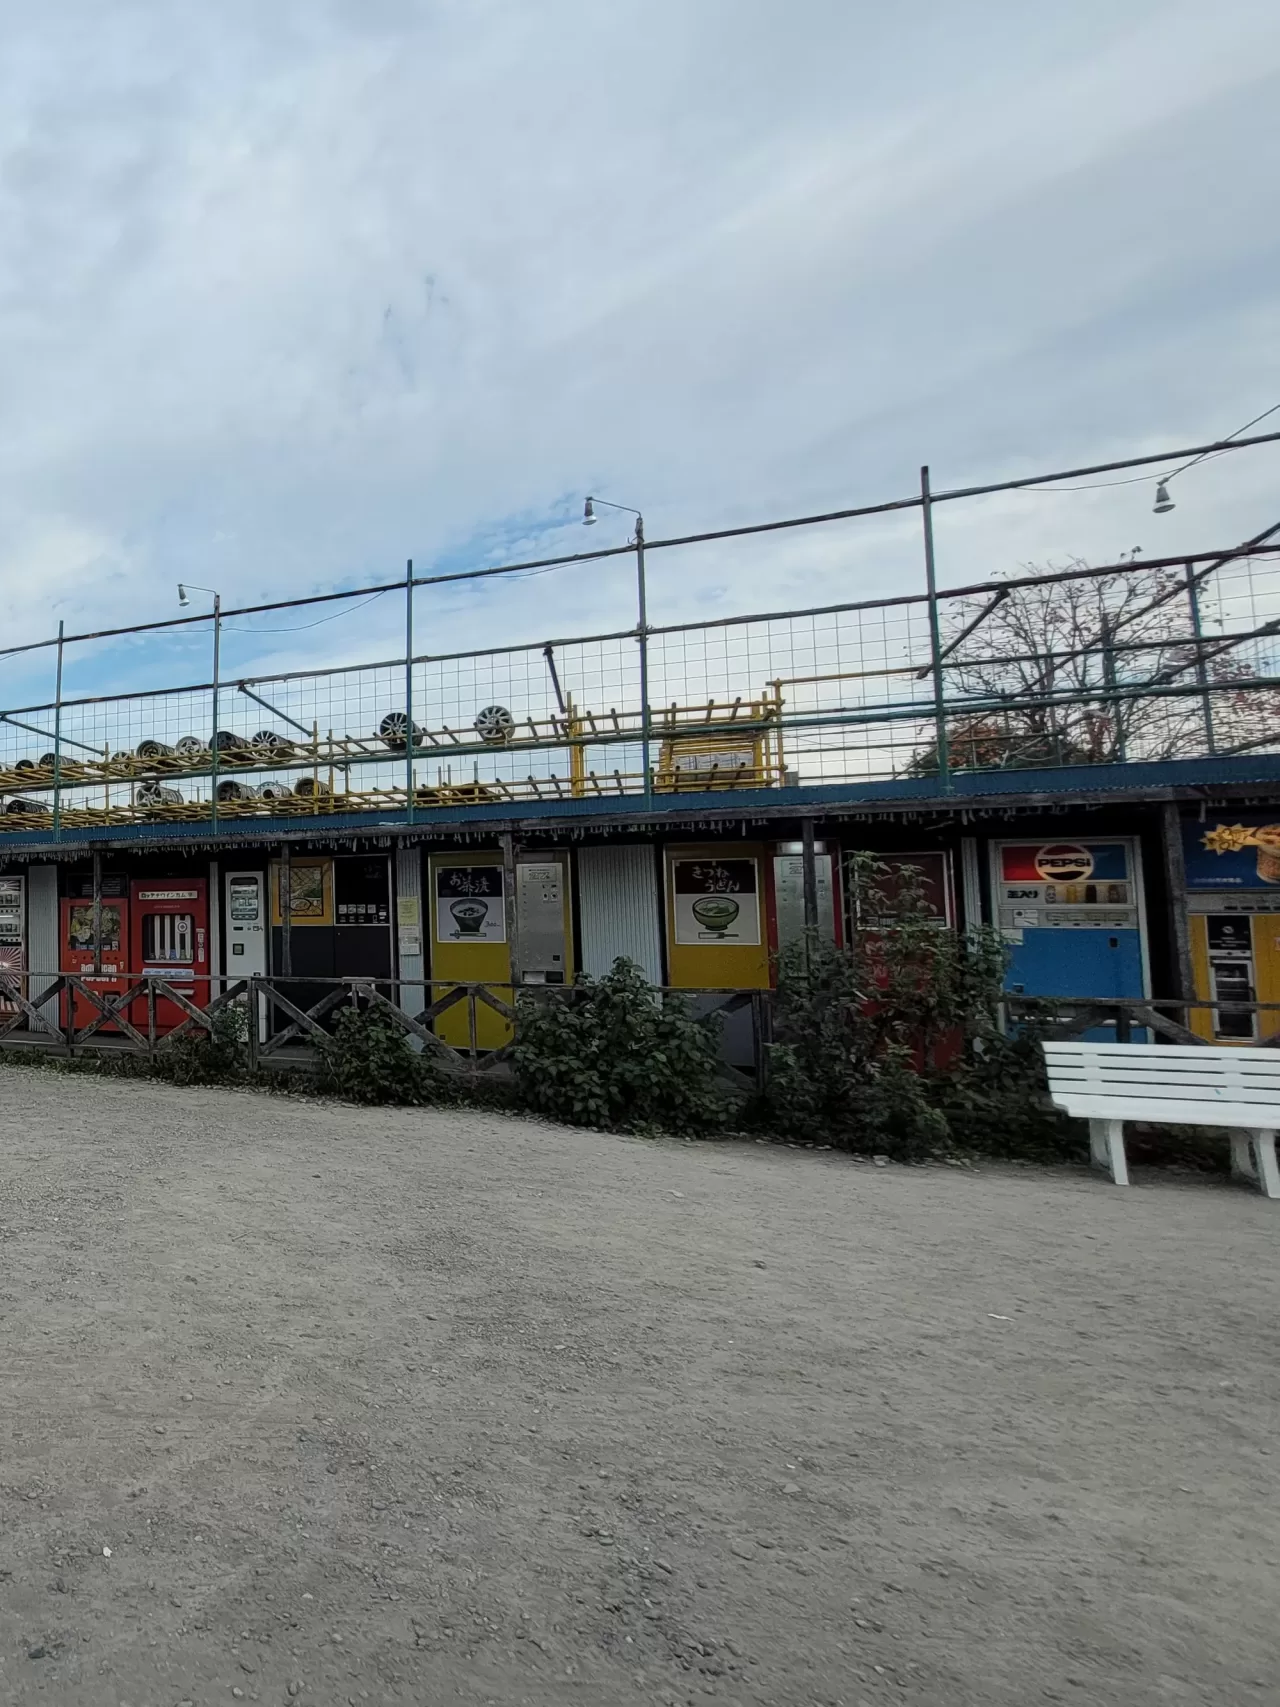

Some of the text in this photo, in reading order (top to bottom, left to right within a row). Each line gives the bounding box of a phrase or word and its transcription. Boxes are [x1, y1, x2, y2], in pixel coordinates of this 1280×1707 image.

[1038, 857, 1091, 868] PEPSI
[691, 865, 730, 879] きつね
[705, 879, 740, 893] うどん
